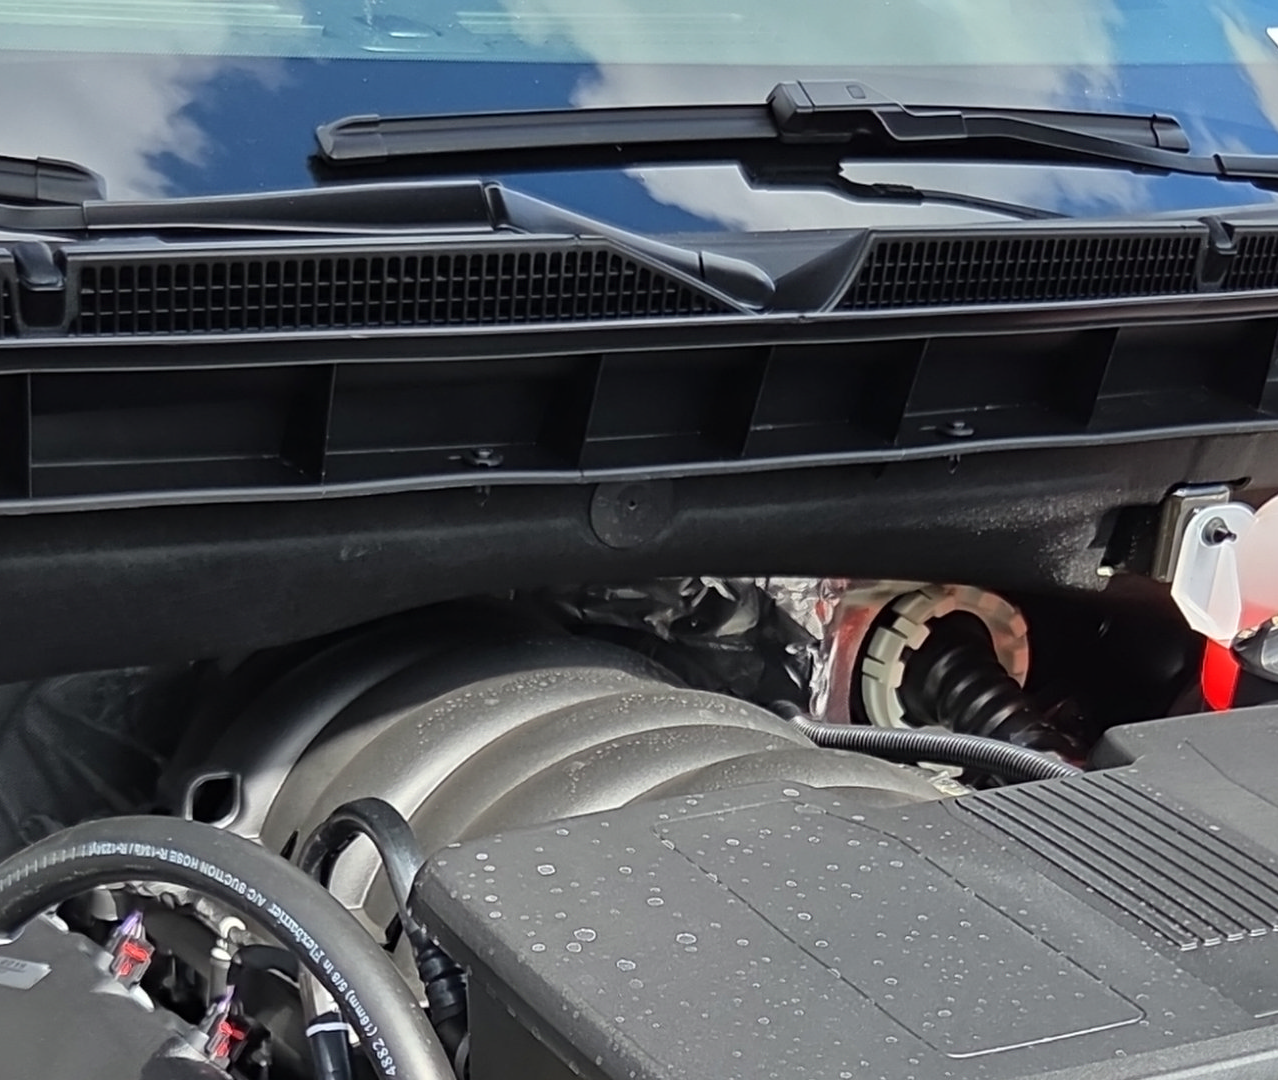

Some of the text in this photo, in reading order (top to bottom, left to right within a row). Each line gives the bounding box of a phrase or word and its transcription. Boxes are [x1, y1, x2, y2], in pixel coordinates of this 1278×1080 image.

[170, 850, 200, 870] HOSE
[199, 861, 249, 896] SUCTION
[245, 888, 267, 907] A/C
[267, 901, 326, 965] Flexbarrier
[330, 973, 349, 994] 5/8
[344, 990, 378, 1037] (16mm)
[372, 1037, 397, 1077] 4882
